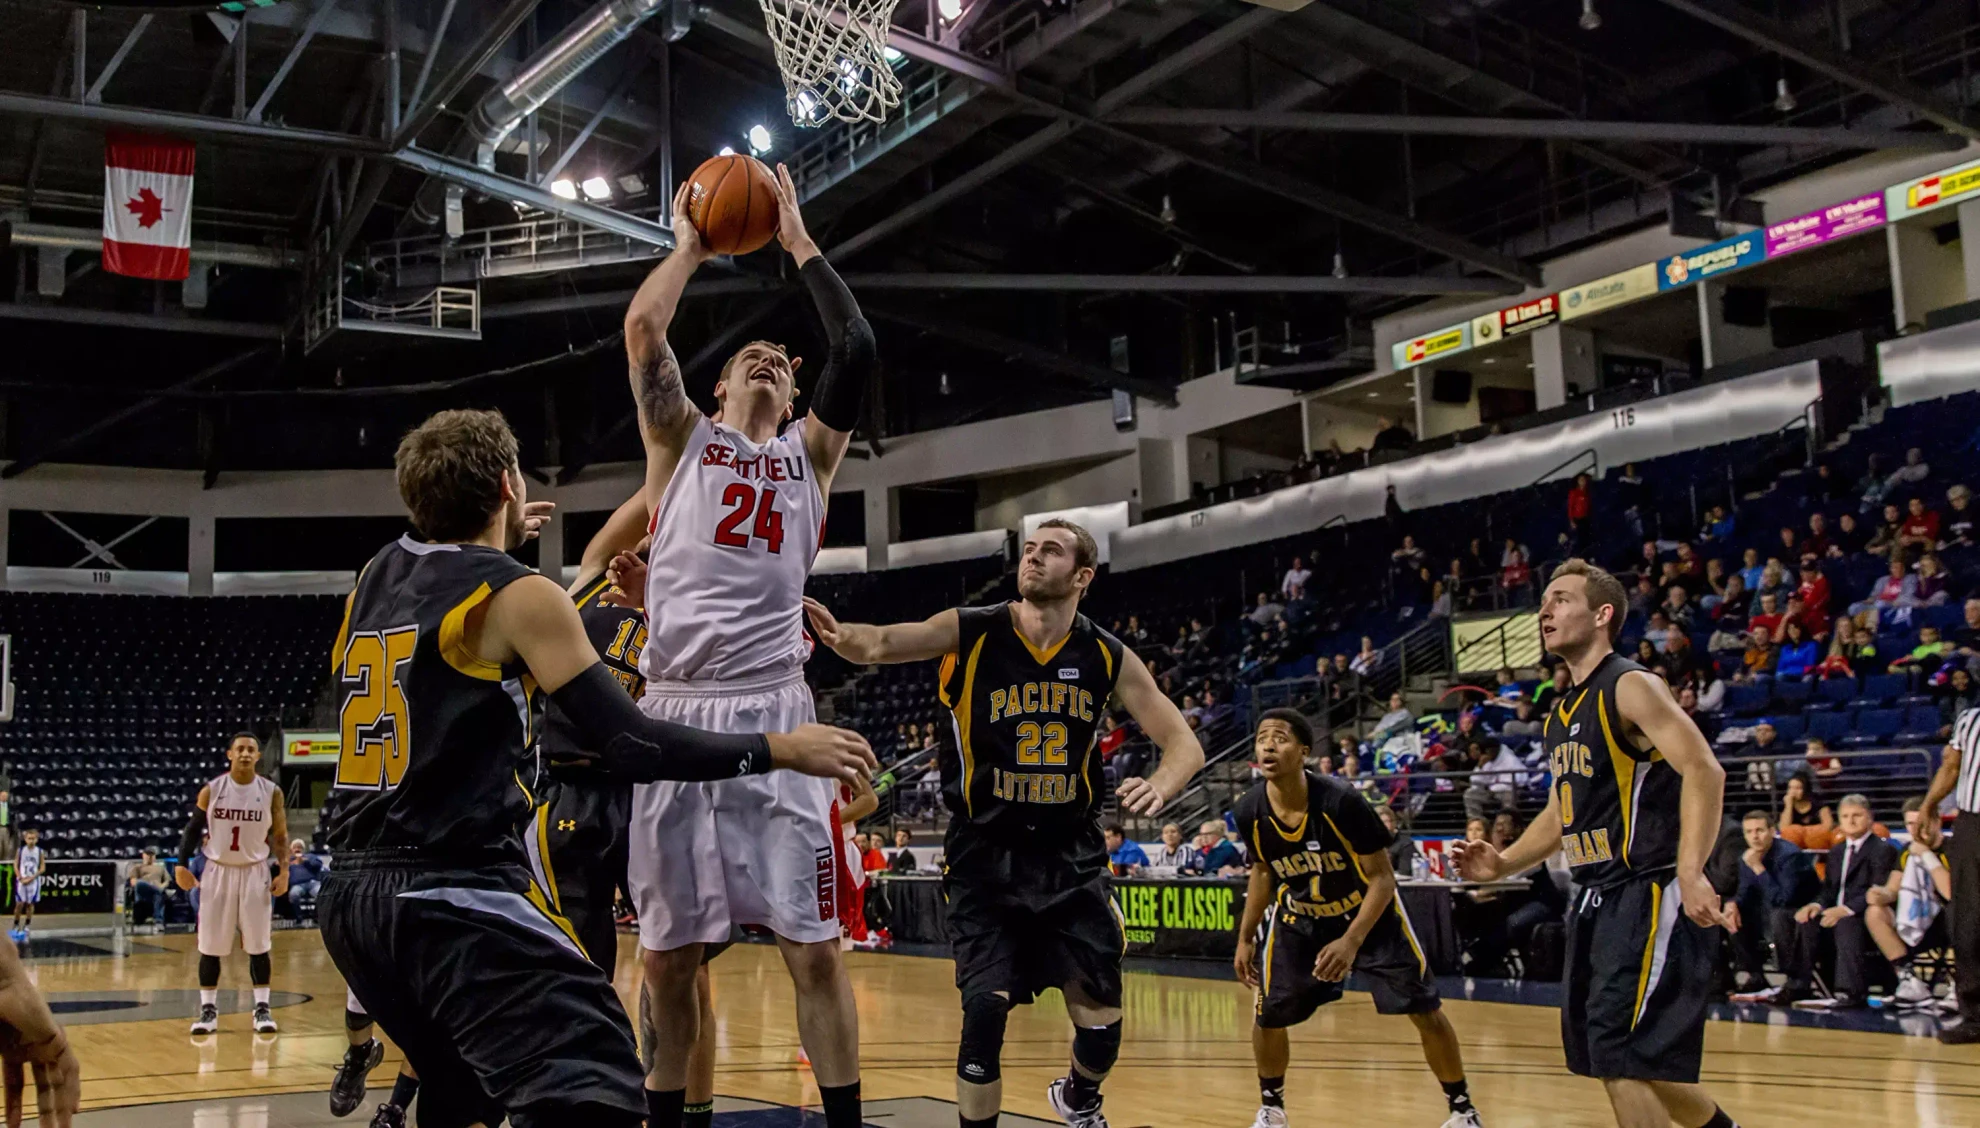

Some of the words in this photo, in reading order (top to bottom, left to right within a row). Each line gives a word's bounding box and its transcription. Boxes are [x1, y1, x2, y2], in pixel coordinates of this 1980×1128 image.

[1688, 240, 1751, 271] REPUBLIC
[1612, 407, 1635, 429] 116
[714, 482, 785, 554] 24
[93, 572, 111, 583] 119
[605, 617, 650, 670] 15
[1061, 670, 1078, 678] TOM
[334, 624, 419, 790] 25
[990, 682, 1094, 723] PACIFIC
[1016, 721, 1068, 766] 22
[993, 767, 1080, 804] LUTHERA
[1560, 781, 1574, 828] 0
[230, 826, 240, 851] 1
[24, 865, 35, 875] 14
[41, 889, 90, 897] NERGY
[1309, 875, 1326, 902] 1
[1114, 886, 1159, 927] LEGE
[1162, 886, 1235, 931] CLASSIC
[1126, 929, 1156, 943] ENERGY
